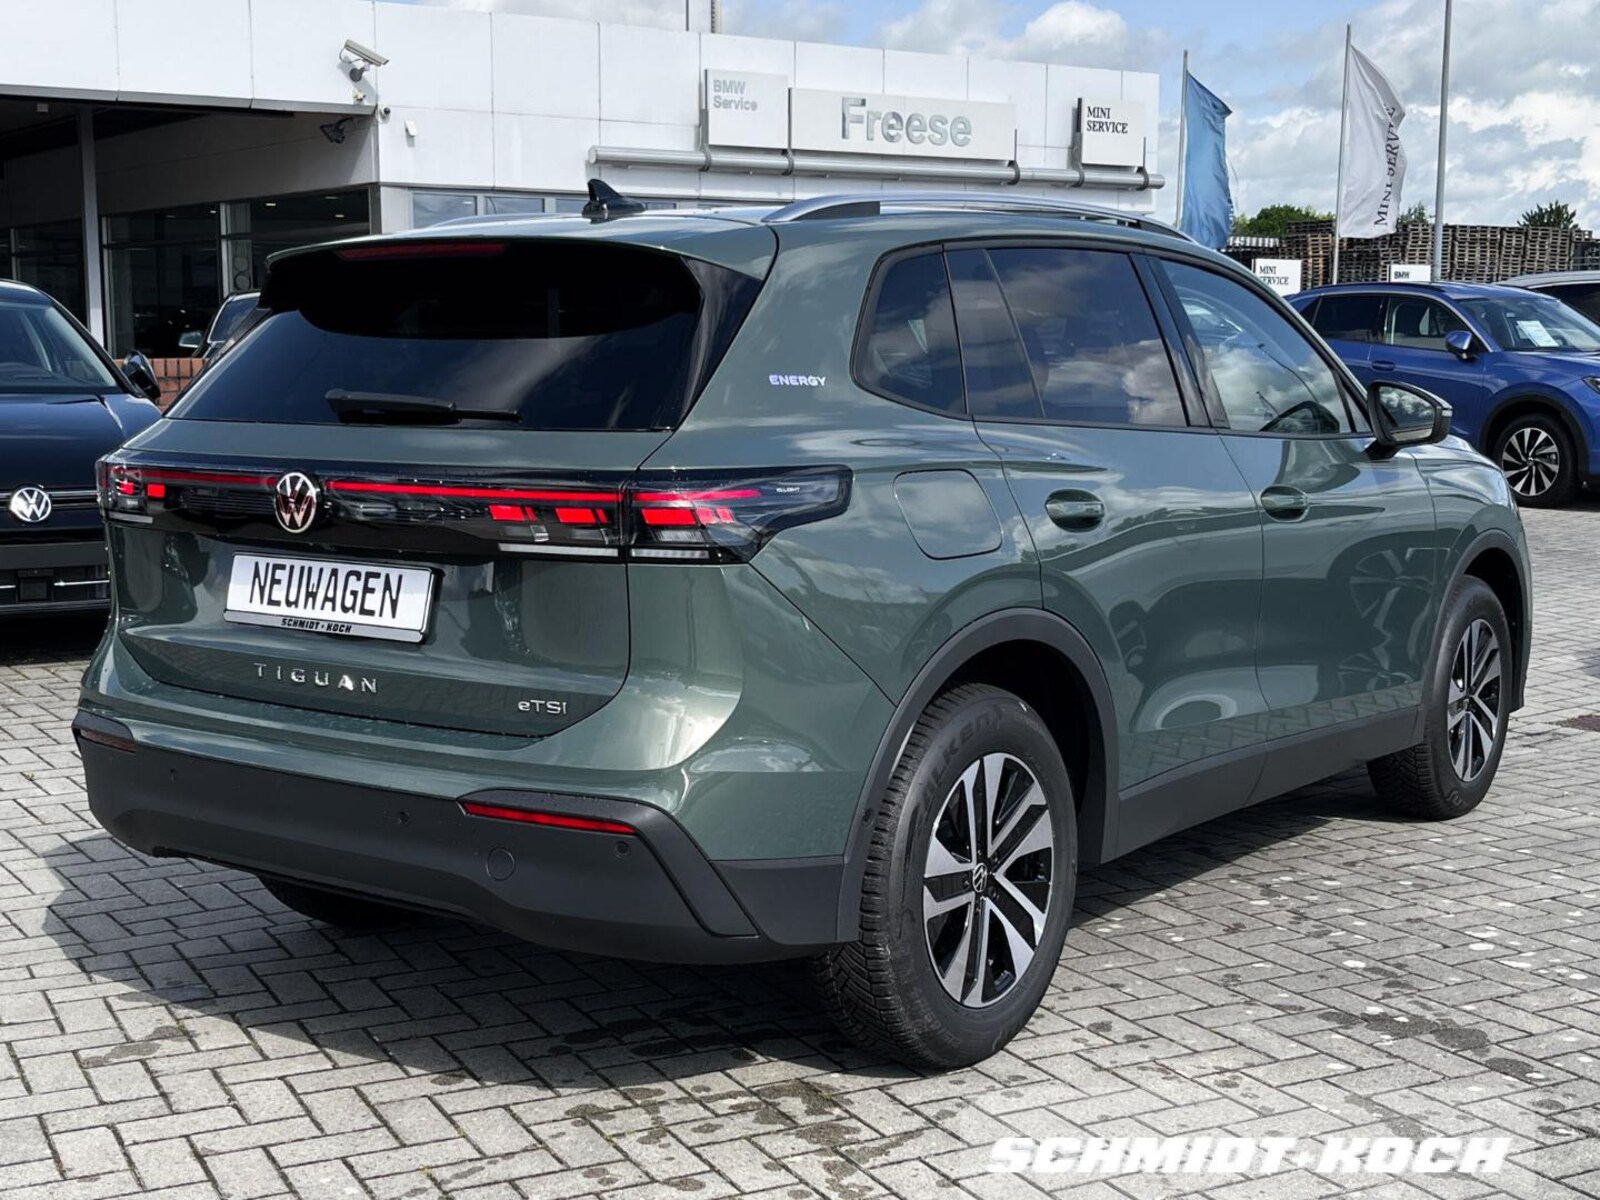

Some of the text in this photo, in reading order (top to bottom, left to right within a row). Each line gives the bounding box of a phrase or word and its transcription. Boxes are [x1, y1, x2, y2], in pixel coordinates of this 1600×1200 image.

[713, 79, 746, 94] BMW
[713, 95, 758, 111] Service
[1087, 106, 1111, 119] MINI
[841, 97, 972, 147] Freese
[1086, 120, 1128, 134] SERVICE
[1374, 104, 1400, 226] MINI SERVE
[1259, 265, 1277, 275] MINI
[1394, 271, 1410, 279] BMW
[769, 374, 826, 387] ENERGY
[249, 561, 403, 619] NEUWAGEN
[254, 662, 378, 694] TIGUAN
[518, 699, 567, 715] eTSI
